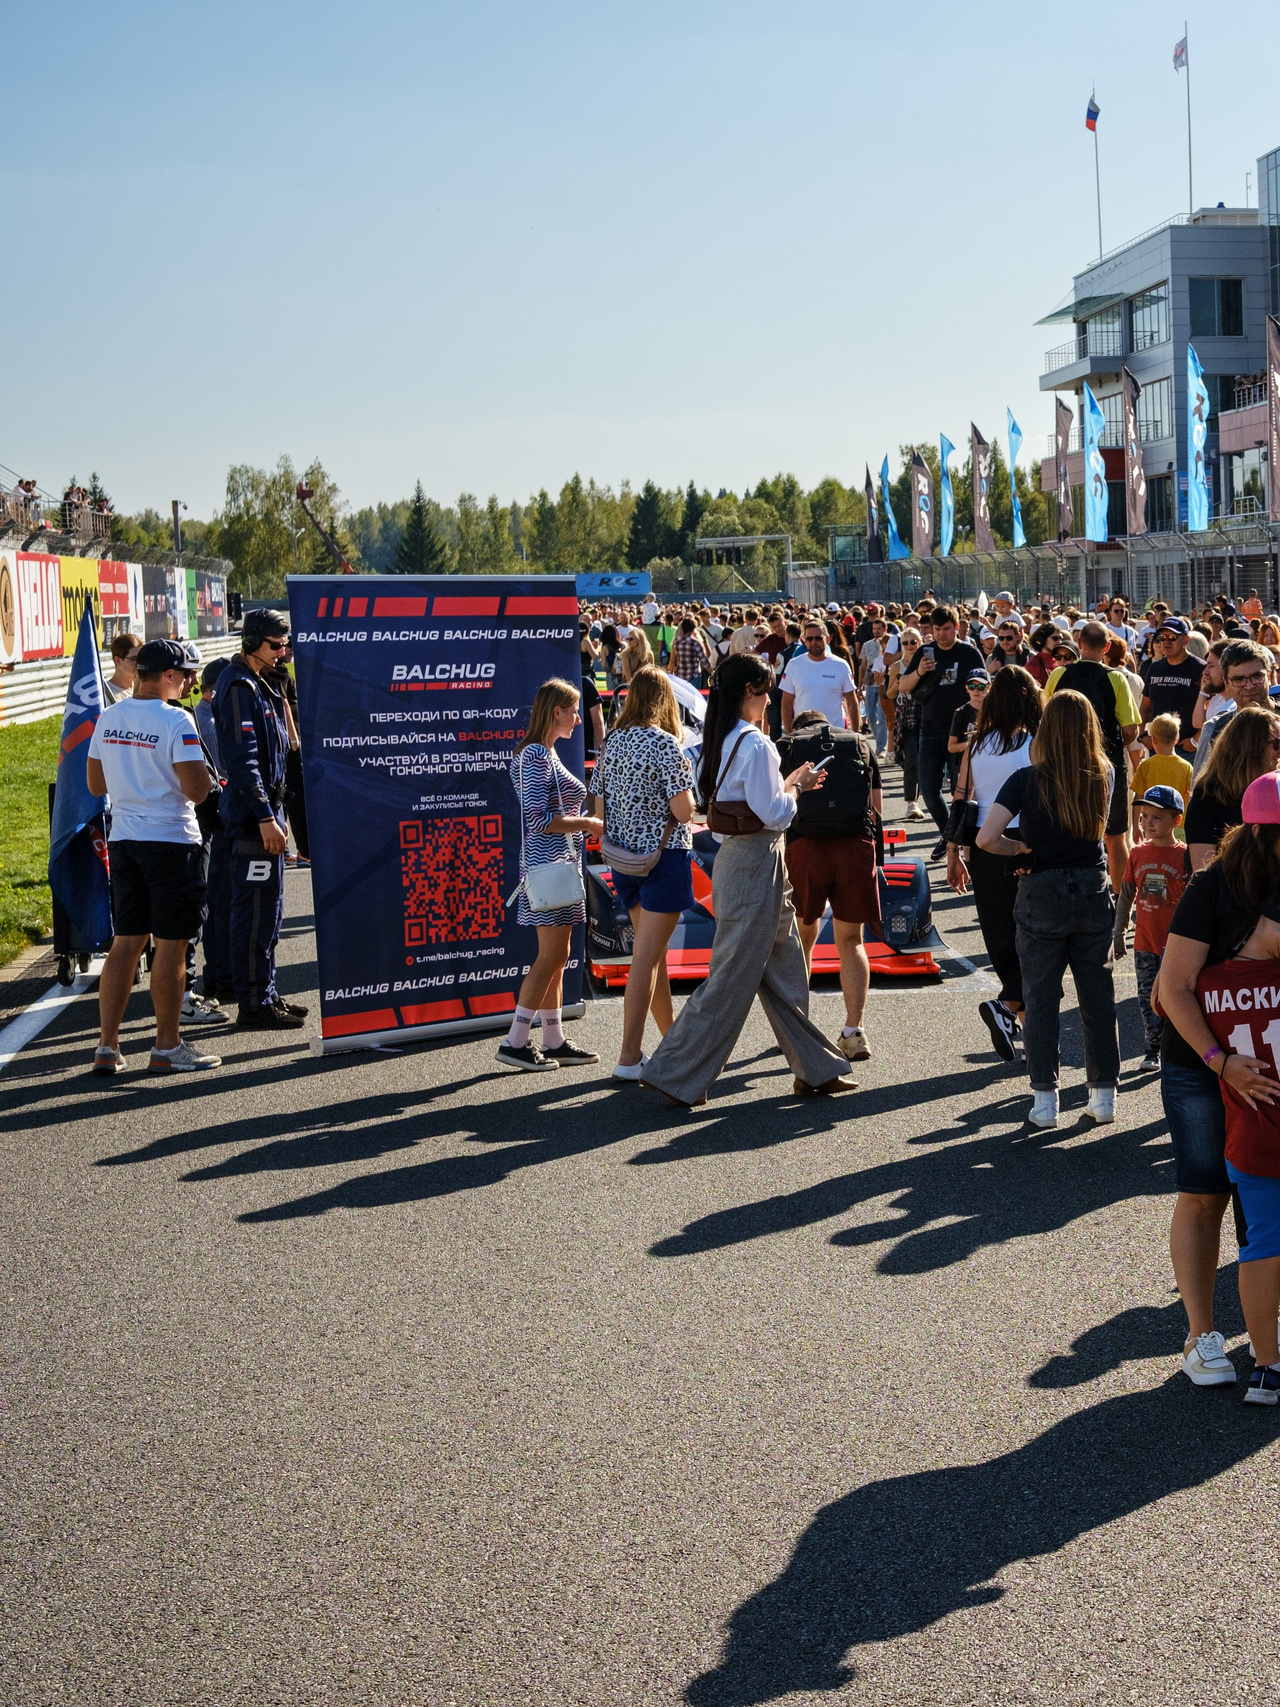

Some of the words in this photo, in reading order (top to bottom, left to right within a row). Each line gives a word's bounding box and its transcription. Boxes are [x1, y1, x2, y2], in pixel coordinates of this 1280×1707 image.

[17, 559, 62, 652] HELLO!
[297, 632, 367, 643] BALCHUG
[372, 630, 439, 641] BALCHUG
[443, 629, 507, 640] BALCHUG
[511, 628, 574, 639] BALCHUG
[392, 663, 496, 680] BALCHUG
[451, 681, 491, 689] RACING
[370, 711, 440, 723] ПЕРЕХОДИ
[443, 710, 459, 721] ПО
[463, 708, 518, 720] QR-КОДУ
[103, 729, 160, 744] BALCHUG
[323, 732, 436, 748] ПОДПИСЫВАЙСЯ
[438, 732, 456, 742] НА
[459, 730, 515, 742] BALCHUG
[359, 753, 429, 767] УЧАСТВУЙ
[432, 754, 439, 763] В
[443, 751, 514, 763] РОЗЫГРЫШ
[390, 763, 462, 776] ГОНОЧНОГО
[465, 761, 507, 772] МЕРЧА
[420, 794, 435, 803] ВСЁ
[443, 793, 479, 802] КОМАНДЕ
[420, 802, 463, 810] ЗАКУЛИСЬЕ
[464, 800, 488, 808] ГОНОК
[246, 860, 272, 881] B
[416, 947, 505, 963] t.me/balchug_racing
[325, 983, 389, 1001] BALCHUG
[393, 974, 454, 991] BALCHUG
[458, 966, 518, 983] BALCHUG
